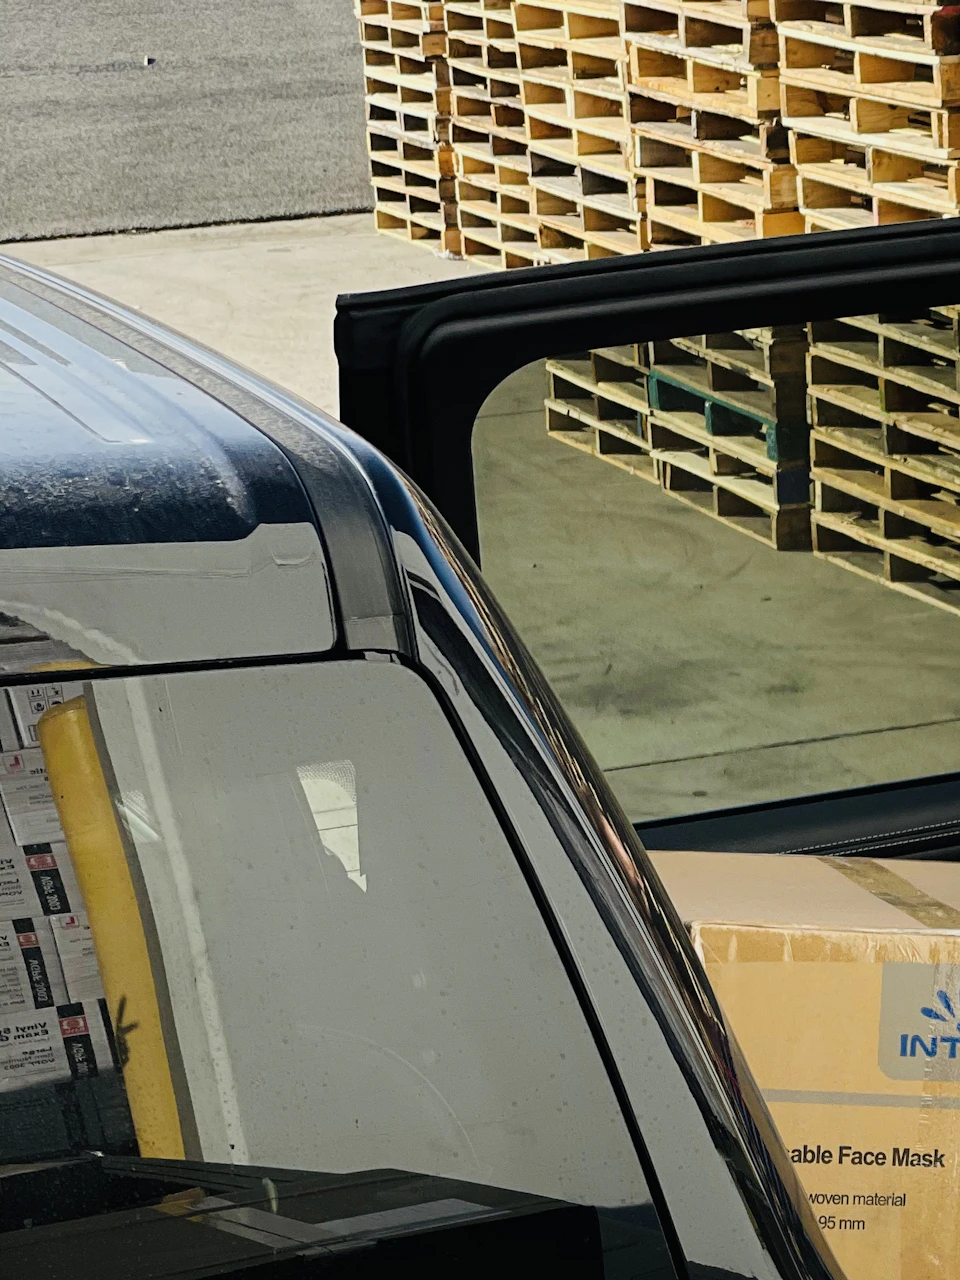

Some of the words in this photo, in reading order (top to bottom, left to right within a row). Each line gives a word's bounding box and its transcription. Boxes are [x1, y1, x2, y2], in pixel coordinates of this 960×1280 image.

[786, 1144, 833, 1165] able
[838, 1145, 887, 1166] Face
[892, 1147, 945, 1168] Mask
[852, 1192, 906, 1206] material
[818, 1215, 836, 1230] 95
[839, 1218, 865, 1230] mm
